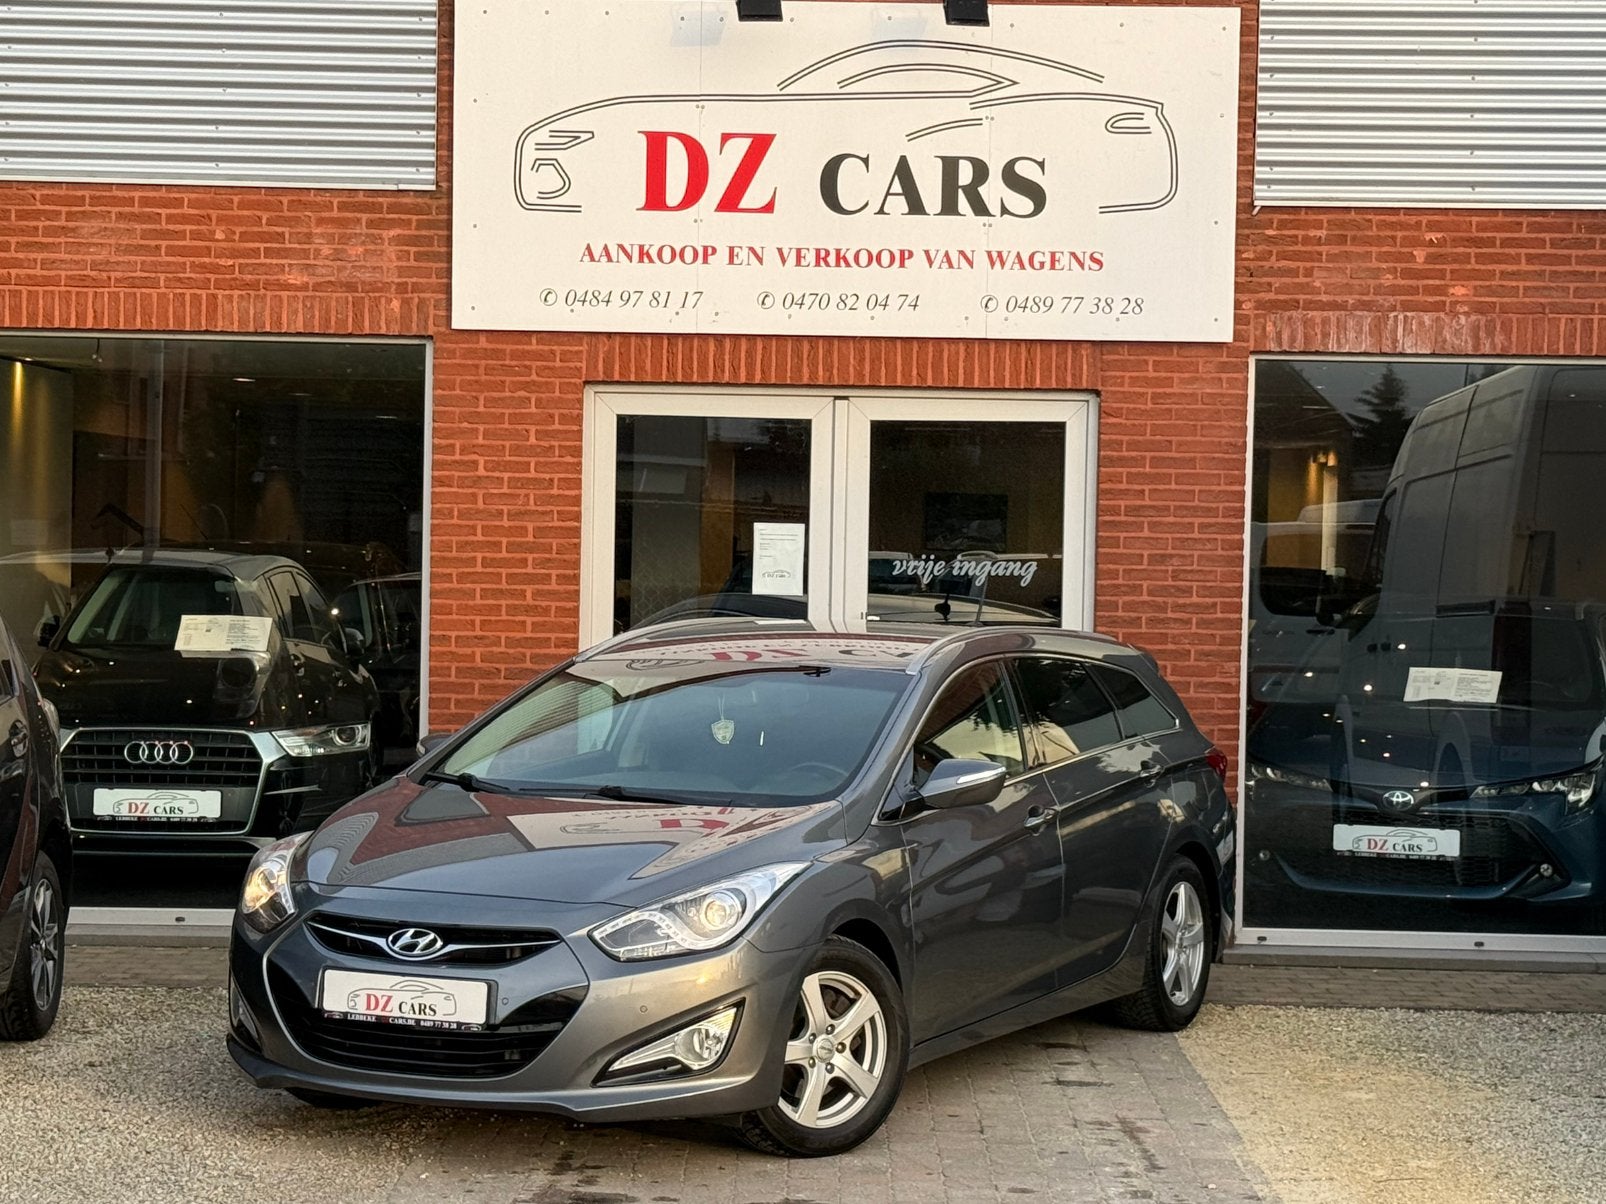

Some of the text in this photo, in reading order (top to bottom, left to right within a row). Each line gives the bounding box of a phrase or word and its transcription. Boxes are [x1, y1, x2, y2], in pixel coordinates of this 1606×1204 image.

[635, 130, 1047, 219] DZ CARS
[579, 242, 1105, 272] AANKOOP EN VERKOOP VAN WAGENS
[564, 289, 704, 309] 0484 97 81 17
[782, 292, 921, 312] 0470 82 04 74
[1005, 295, 1145, 315] 0489 77 38 28
[892, 554, 1038, 587] vrije ingang
[128, 801, 184, 816] DZ CARS
[1367, 838, 1423, 853] DZ CARS
[365, 993, 437, 1017] DZ CARS
